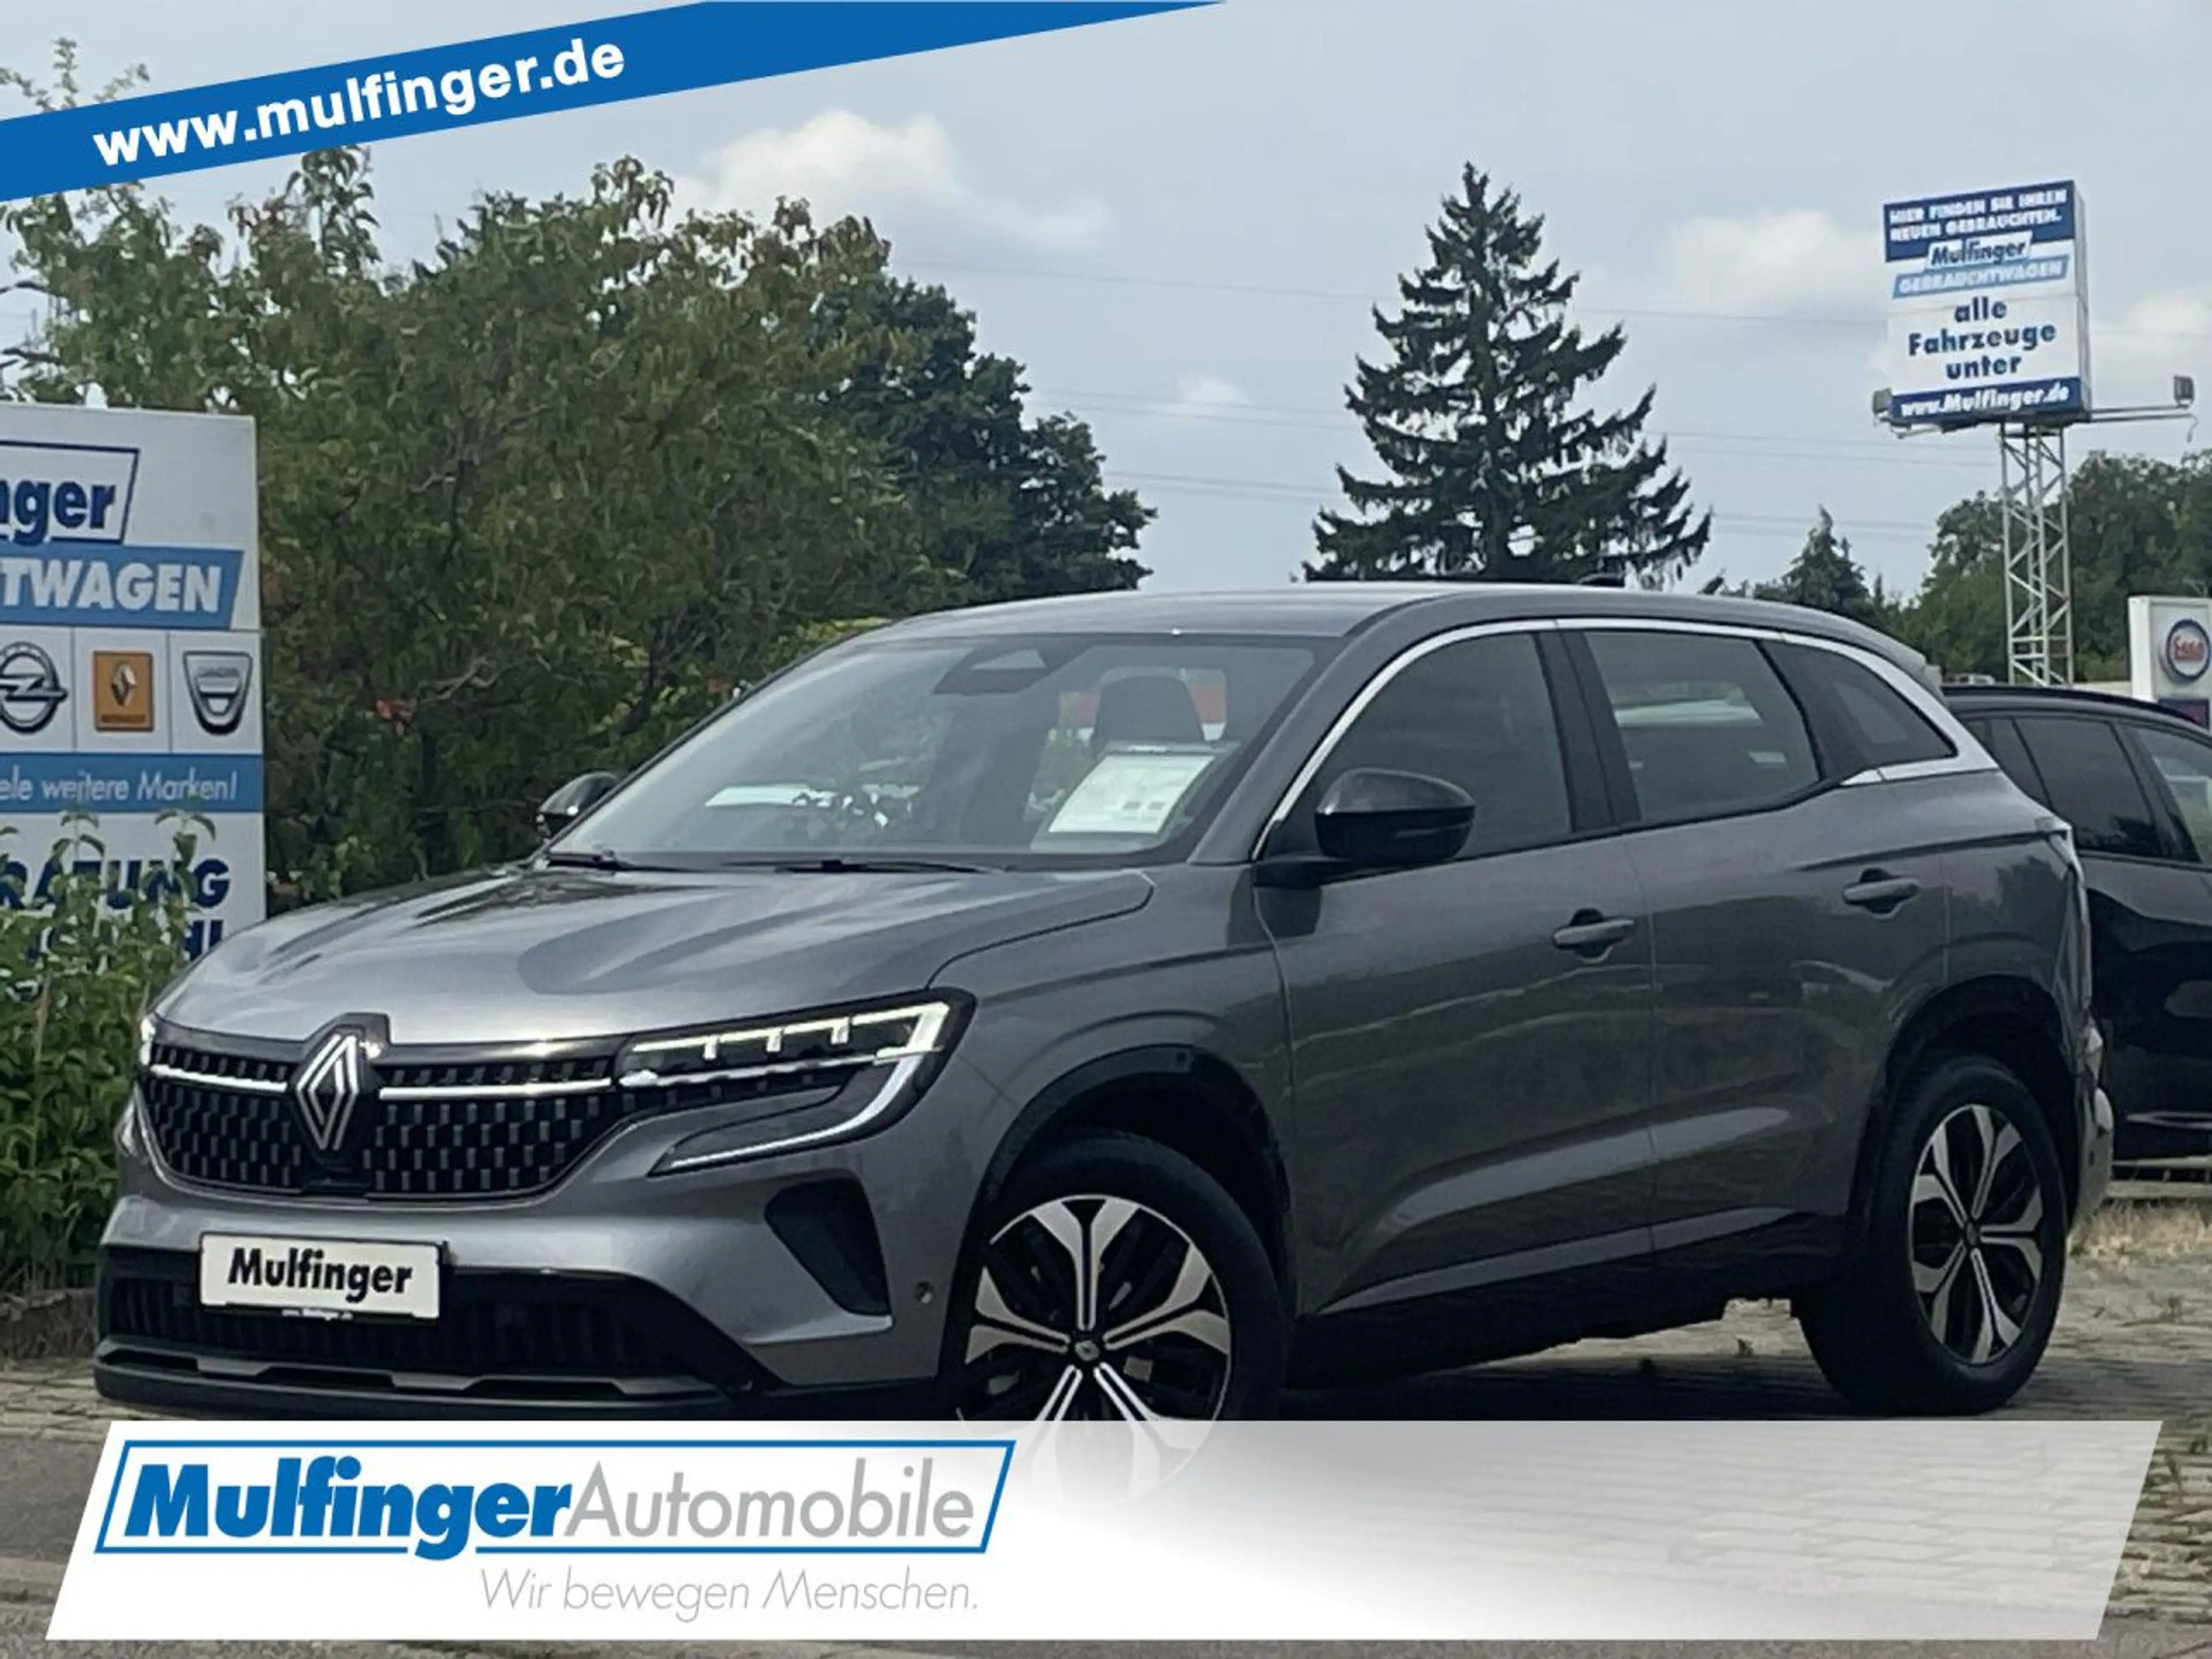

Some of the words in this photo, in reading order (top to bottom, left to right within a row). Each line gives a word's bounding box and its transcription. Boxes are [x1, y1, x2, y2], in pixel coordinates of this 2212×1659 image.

[1931, 240, 2025, 266] Mulfinger
[1899, 260, 2062, 293] GEBRAUCHTWAGEN
[1955, 296, 2007, 323] alle
[1909, 325, 2056, 356] Fahrzeuge
[1946, 355, 2022, 380] unter
[1901, 382, 2070, 416] www.Mulfinger.de
[0, 557, 222, 612] TWAGEN
[41, 769, 130, 802] weitere
[137, 766, 238, 801] Marken!
[228, 1247, 413, 1303] Mulfinger
